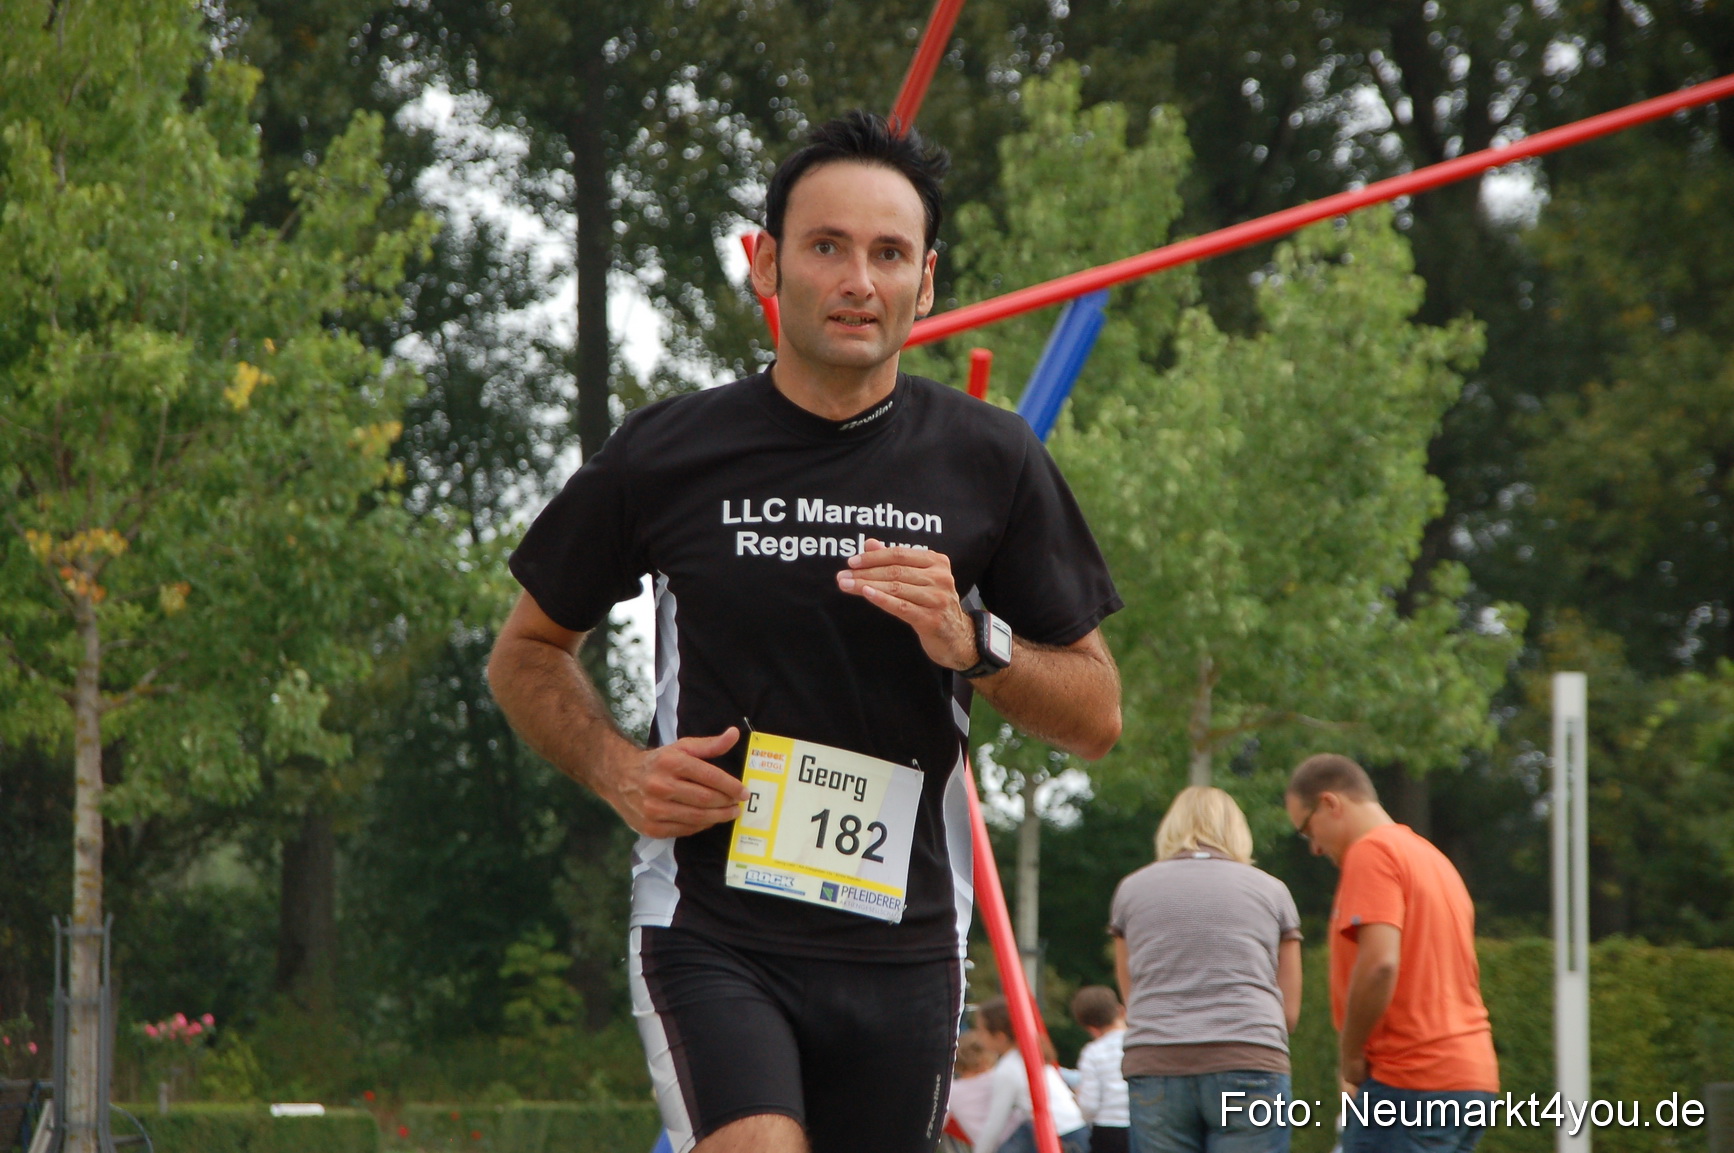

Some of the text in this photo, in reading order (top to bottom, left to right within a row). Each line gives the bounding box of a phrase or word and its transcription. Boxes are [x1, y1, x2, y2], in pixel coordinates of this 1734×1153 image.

[722, 497, 943, 534] LLC Marathon
[736, 531, 929, 562] Regens
[798, 754, 868, 802] Georg
[810, 808, 888, 864] 182
[841, 885, 902, 912] PFLEIDERER
